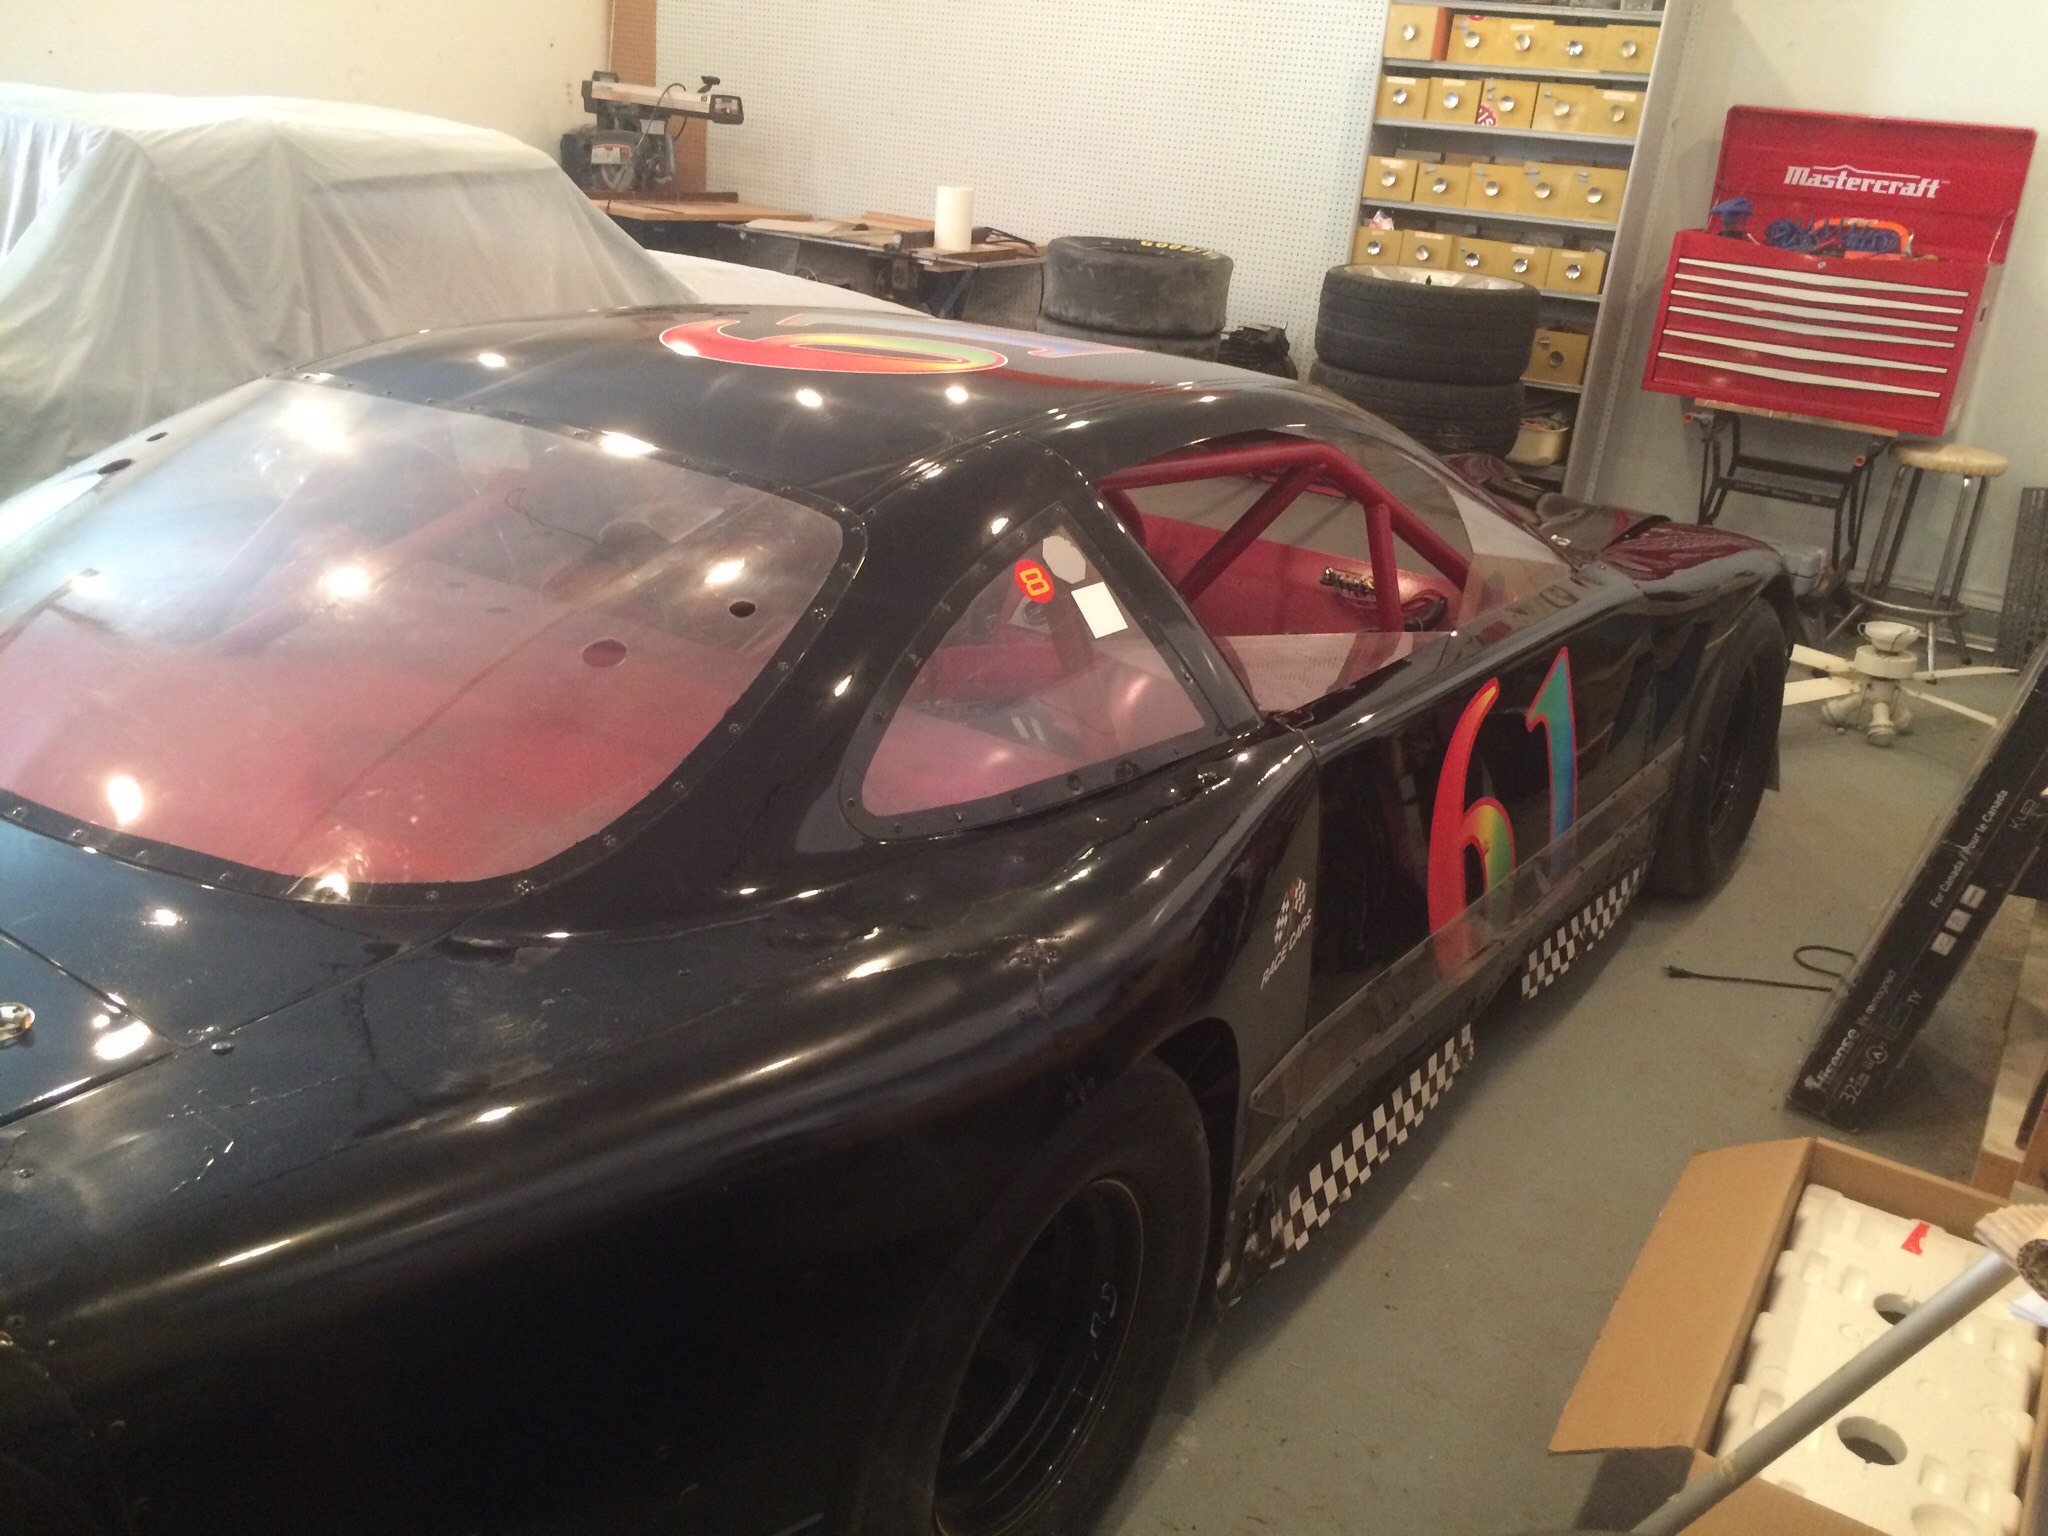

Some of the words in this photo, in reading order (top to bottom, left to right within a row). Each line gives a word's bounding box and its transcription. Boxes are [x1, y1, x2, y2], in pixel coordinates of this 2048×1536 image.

[1783, 164, 1941, 199] Mastercraft
[1019, 567, 1051, 597] 8
[1427, 645, 1578, 987] 61
[1929, 894, 1945, 909] For
[1940, 859, 1965, 893] Canada
[1975, 822, 1988, 834] le
[1982, 789, 2010, 823] Canada
[1260, 941, 1289, 990] RACE
[1288, 907, 1312, 951] CARS
[1839, 1083, 1863, 1105] 32
